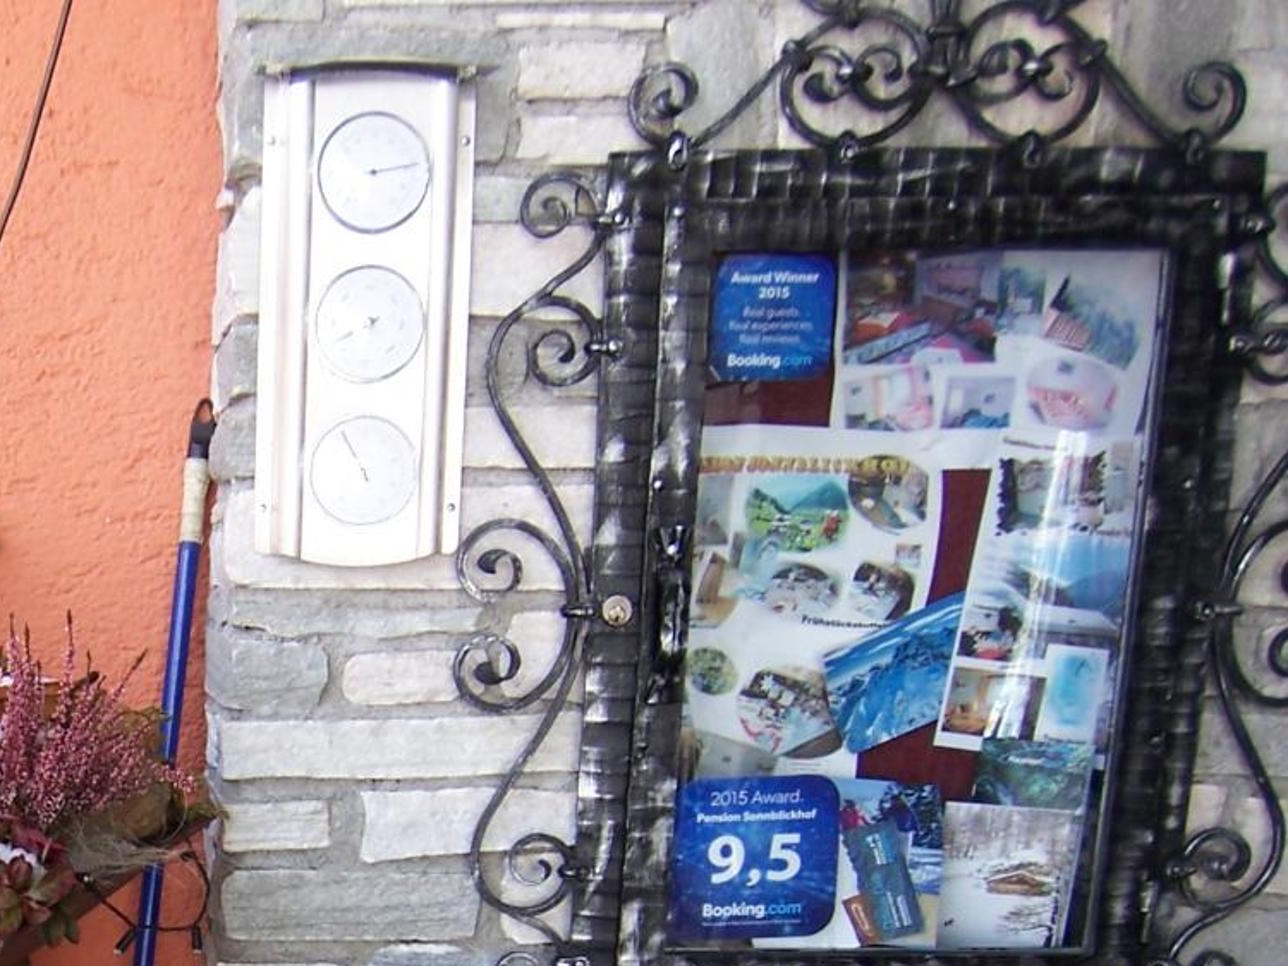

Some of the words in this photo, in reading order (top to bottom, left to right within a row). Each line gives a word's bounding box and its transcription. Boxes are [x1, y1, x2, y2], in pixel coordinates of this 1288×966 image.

[731, 271, 772, 283] Award
[774, 271, 819, 283] Winner
[759, 287, 790, 299] 2015
[727, 352, 813, 369] Booking.com
[710, 791, 748, 807] 2015
[696, 812, 741, 823] Pension
[743, 808, 818, 821] Sonnblickhof
[707, 833, 802, 886] 9,5
[702, 902, 801, 918] Booking.com
